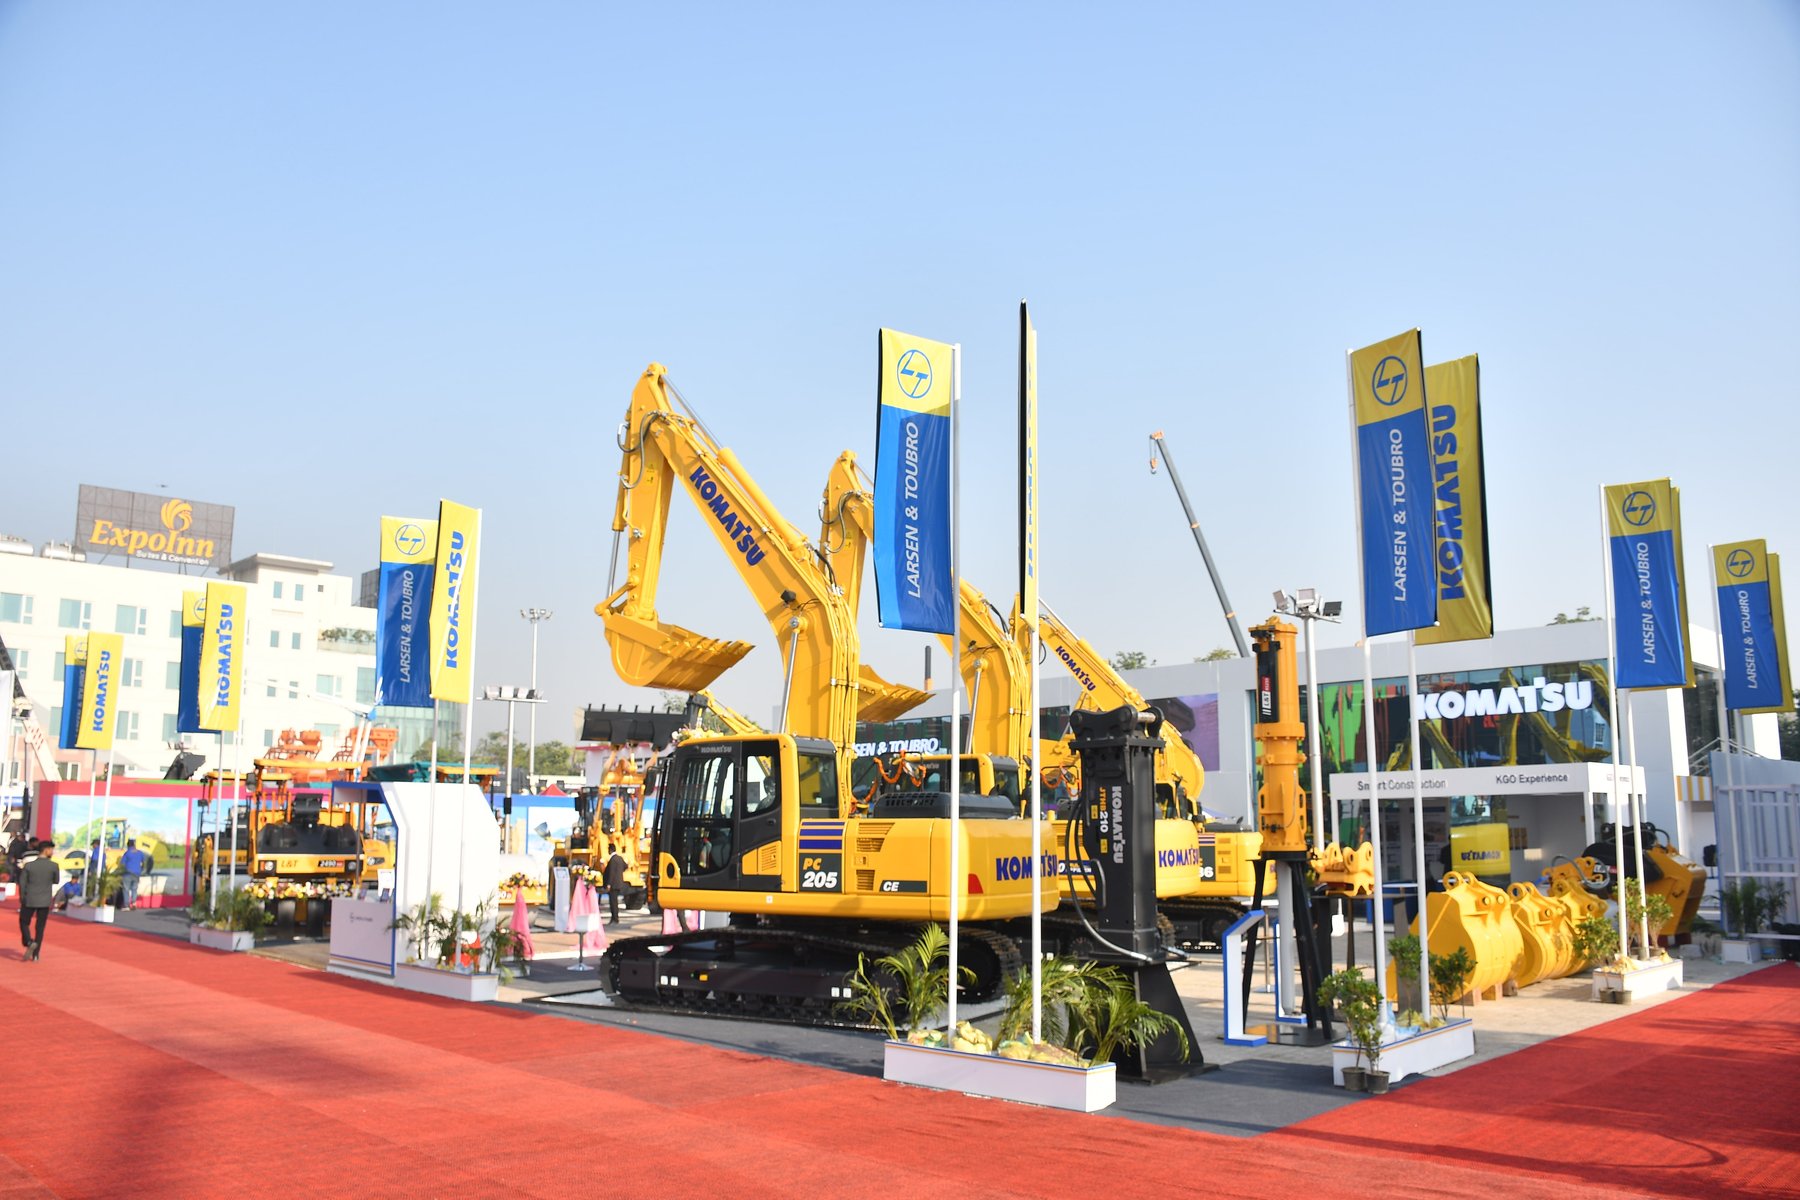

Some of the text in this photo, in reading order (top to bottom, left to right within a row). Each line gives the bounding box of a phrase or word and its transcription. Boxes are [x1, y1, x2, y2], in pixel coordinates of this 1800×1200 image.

[689, 465, 766, 566] KOMATSU
[904, 421, 921, 599] LARSEN & TOUBRO
[1389, 428, 1407, 602] LARSEN & TOUBRO
[1431, 404, 1466, 600] KOMATSU
[88, 519, 215, 558] ExpoInn
[135, 549, 210, 566] Sutes & Conventon
[445, 530, 465, 669] KOMATSU
[1637, 542, 1656, 664] LARSEN & TOUBRO
[400, 570, 415, 683] LARSEN & TOUBRO
[1738, 590, 1758, 689] LARSEN & TOUBRO
[216, 604, 233, 707] KOMATSU
[1055, 645, 1096, 691] KOMATSU
[92, 650, 111, 732] KOMATSU
[1416, 676, 1593, 720] KOMATSU
[700, 745, 732, 753] KOMATSU
[852, 738, 939, 757] SEN & TOUBRO
[1357, 778, 1446, 791] Smrt Constuction
[1519, 773, 1569, 785] Experience
[1111, 786, 1126, 864] KOMATSU
[803, 857, 822, 870] PC
[996, 850, 1058, 881] KOMTSU
[1158, 844, 1199, 868] KOMATSU
[802, 871, 838, 889] 205
[882, 881, 900, 892] CE
